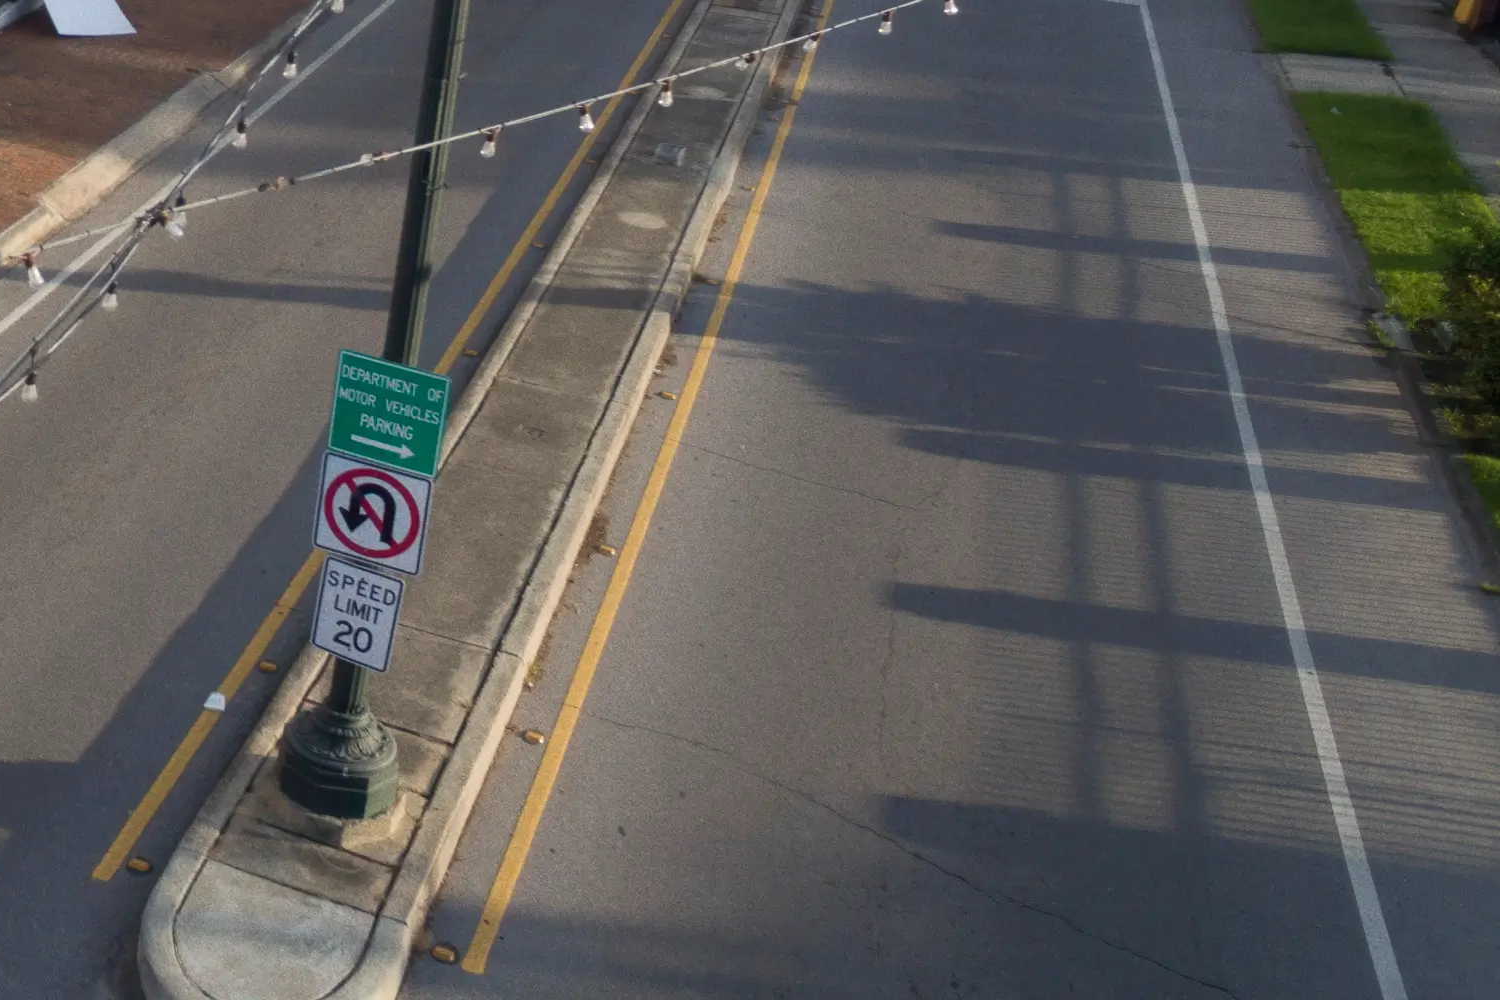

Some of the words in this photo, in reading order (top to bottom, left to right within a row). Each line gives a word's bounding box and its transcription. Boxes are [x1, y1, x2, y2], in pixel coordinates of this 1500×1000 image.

[341, 364, 419, 396] DEPARTMENT
[427, 387, 445, 402] OF
[339, 386, 377, 408] MOTOR
[385, 398, 440, 425] VEHICLES
[360, 413, 414, 441] PARKING
[328, 570, 396, 606] SPEED
[334, 593, 383, 625] LIMIT
[332, 619, 373, 654] 20
